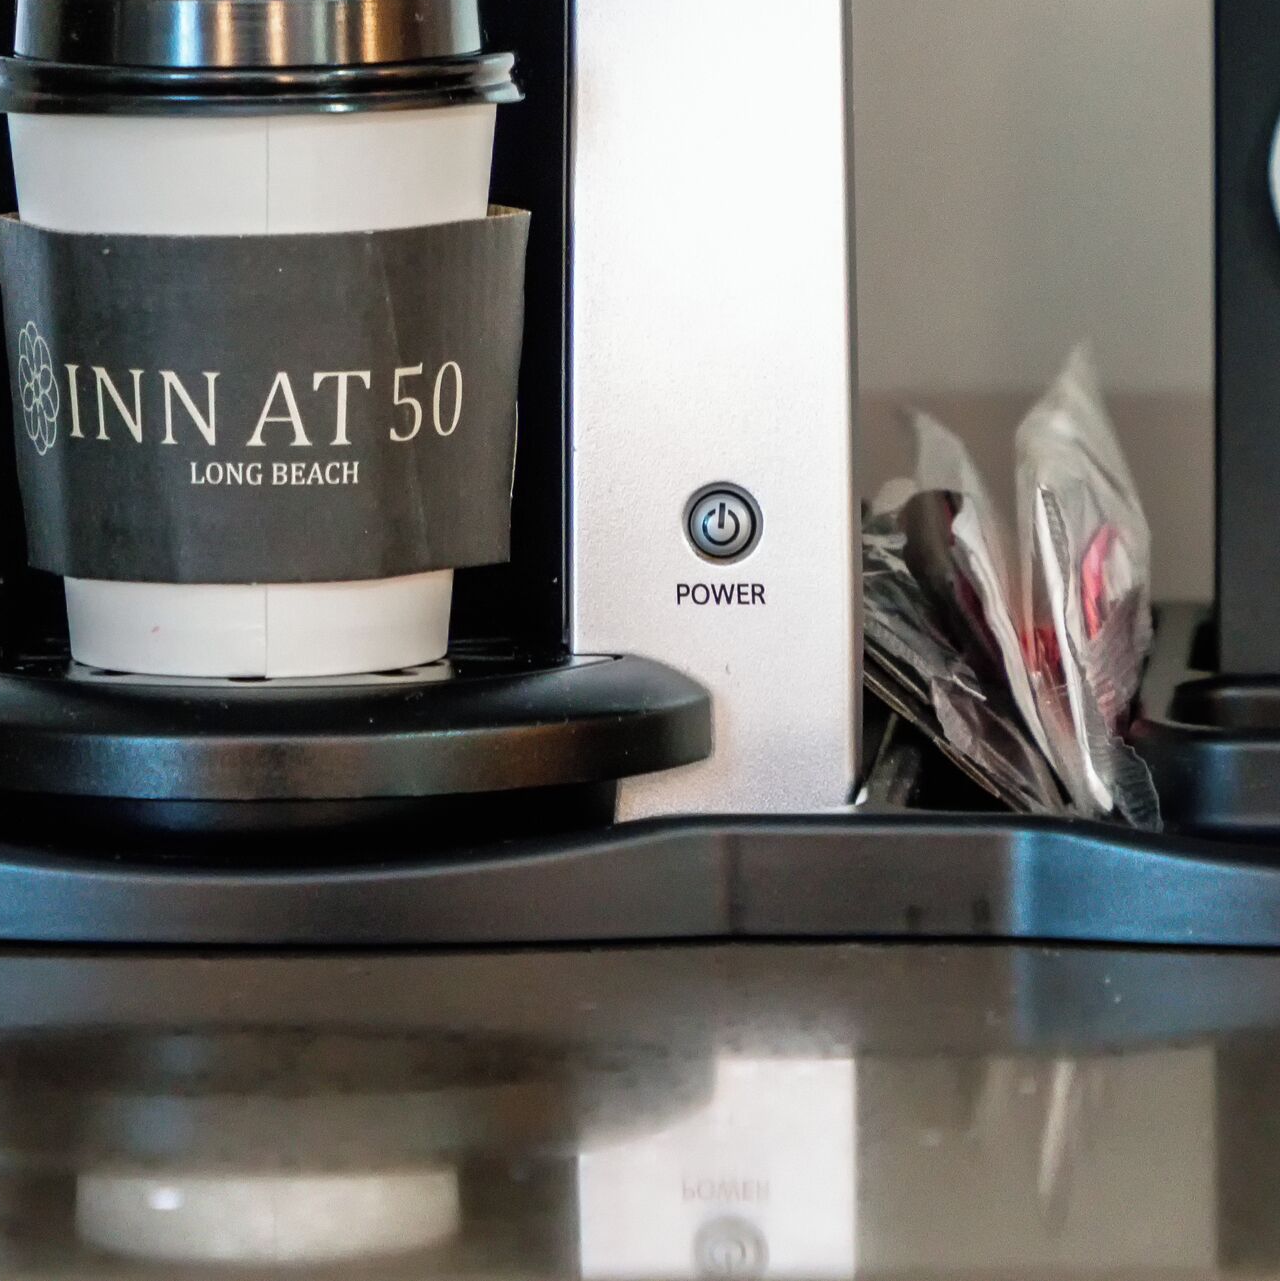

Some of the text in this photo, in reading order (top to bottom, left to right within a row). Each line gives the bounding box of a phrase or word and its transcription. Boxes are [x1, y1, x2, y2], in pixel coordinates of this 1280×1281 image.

[63, 361, 464, 447] INN AT 50
[189, 460, 360, 486] LONG BEACH
[676, 583, 766, 605] POWER
